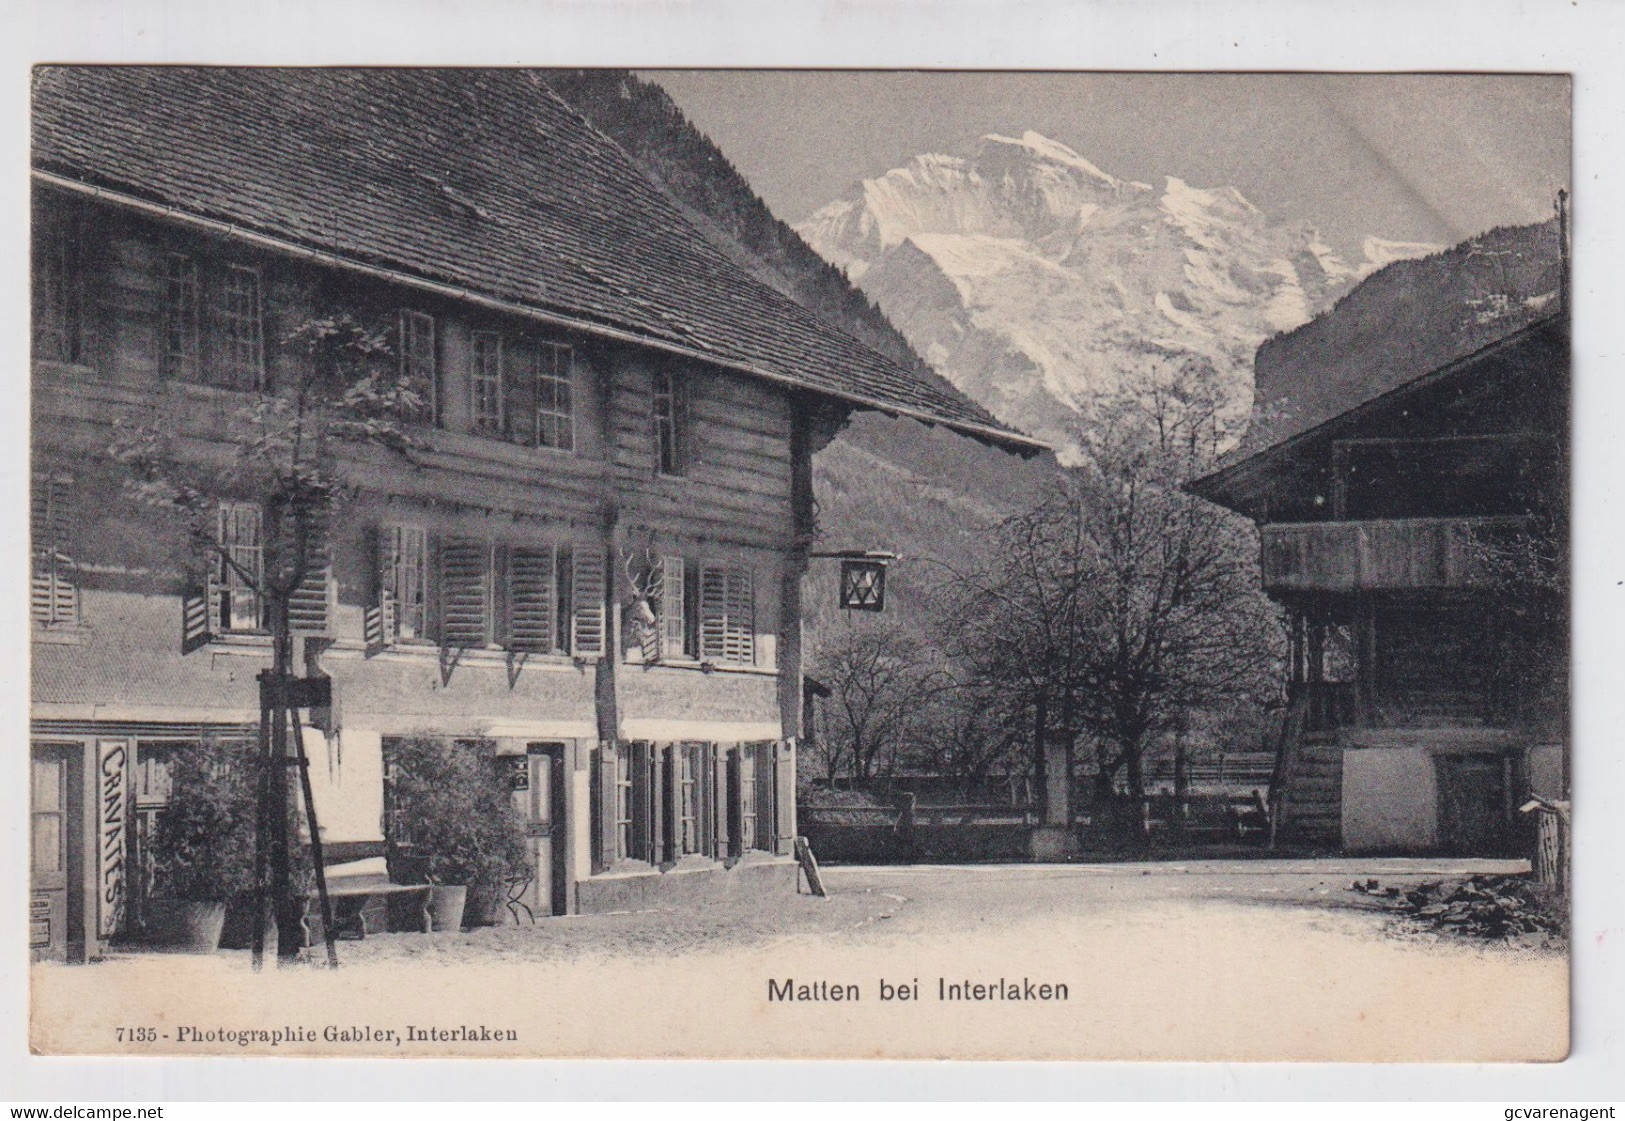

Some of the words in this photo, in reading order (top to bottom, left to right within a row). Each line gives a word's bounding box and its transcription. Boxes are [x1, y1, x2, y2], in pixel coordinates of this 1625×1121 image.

[768, 978, 860, 1002] Matten
[880, 978, 918, 1001] bei
[939, 977, 1069, 1001] Interlaken
[115, 1026, 157, 1042] 7135
[176, 1025, 317, 1046] Photographie
[323, 1025, 401, 1047] Gabler,
[407, 1025, 518, 1042] Interlaken
